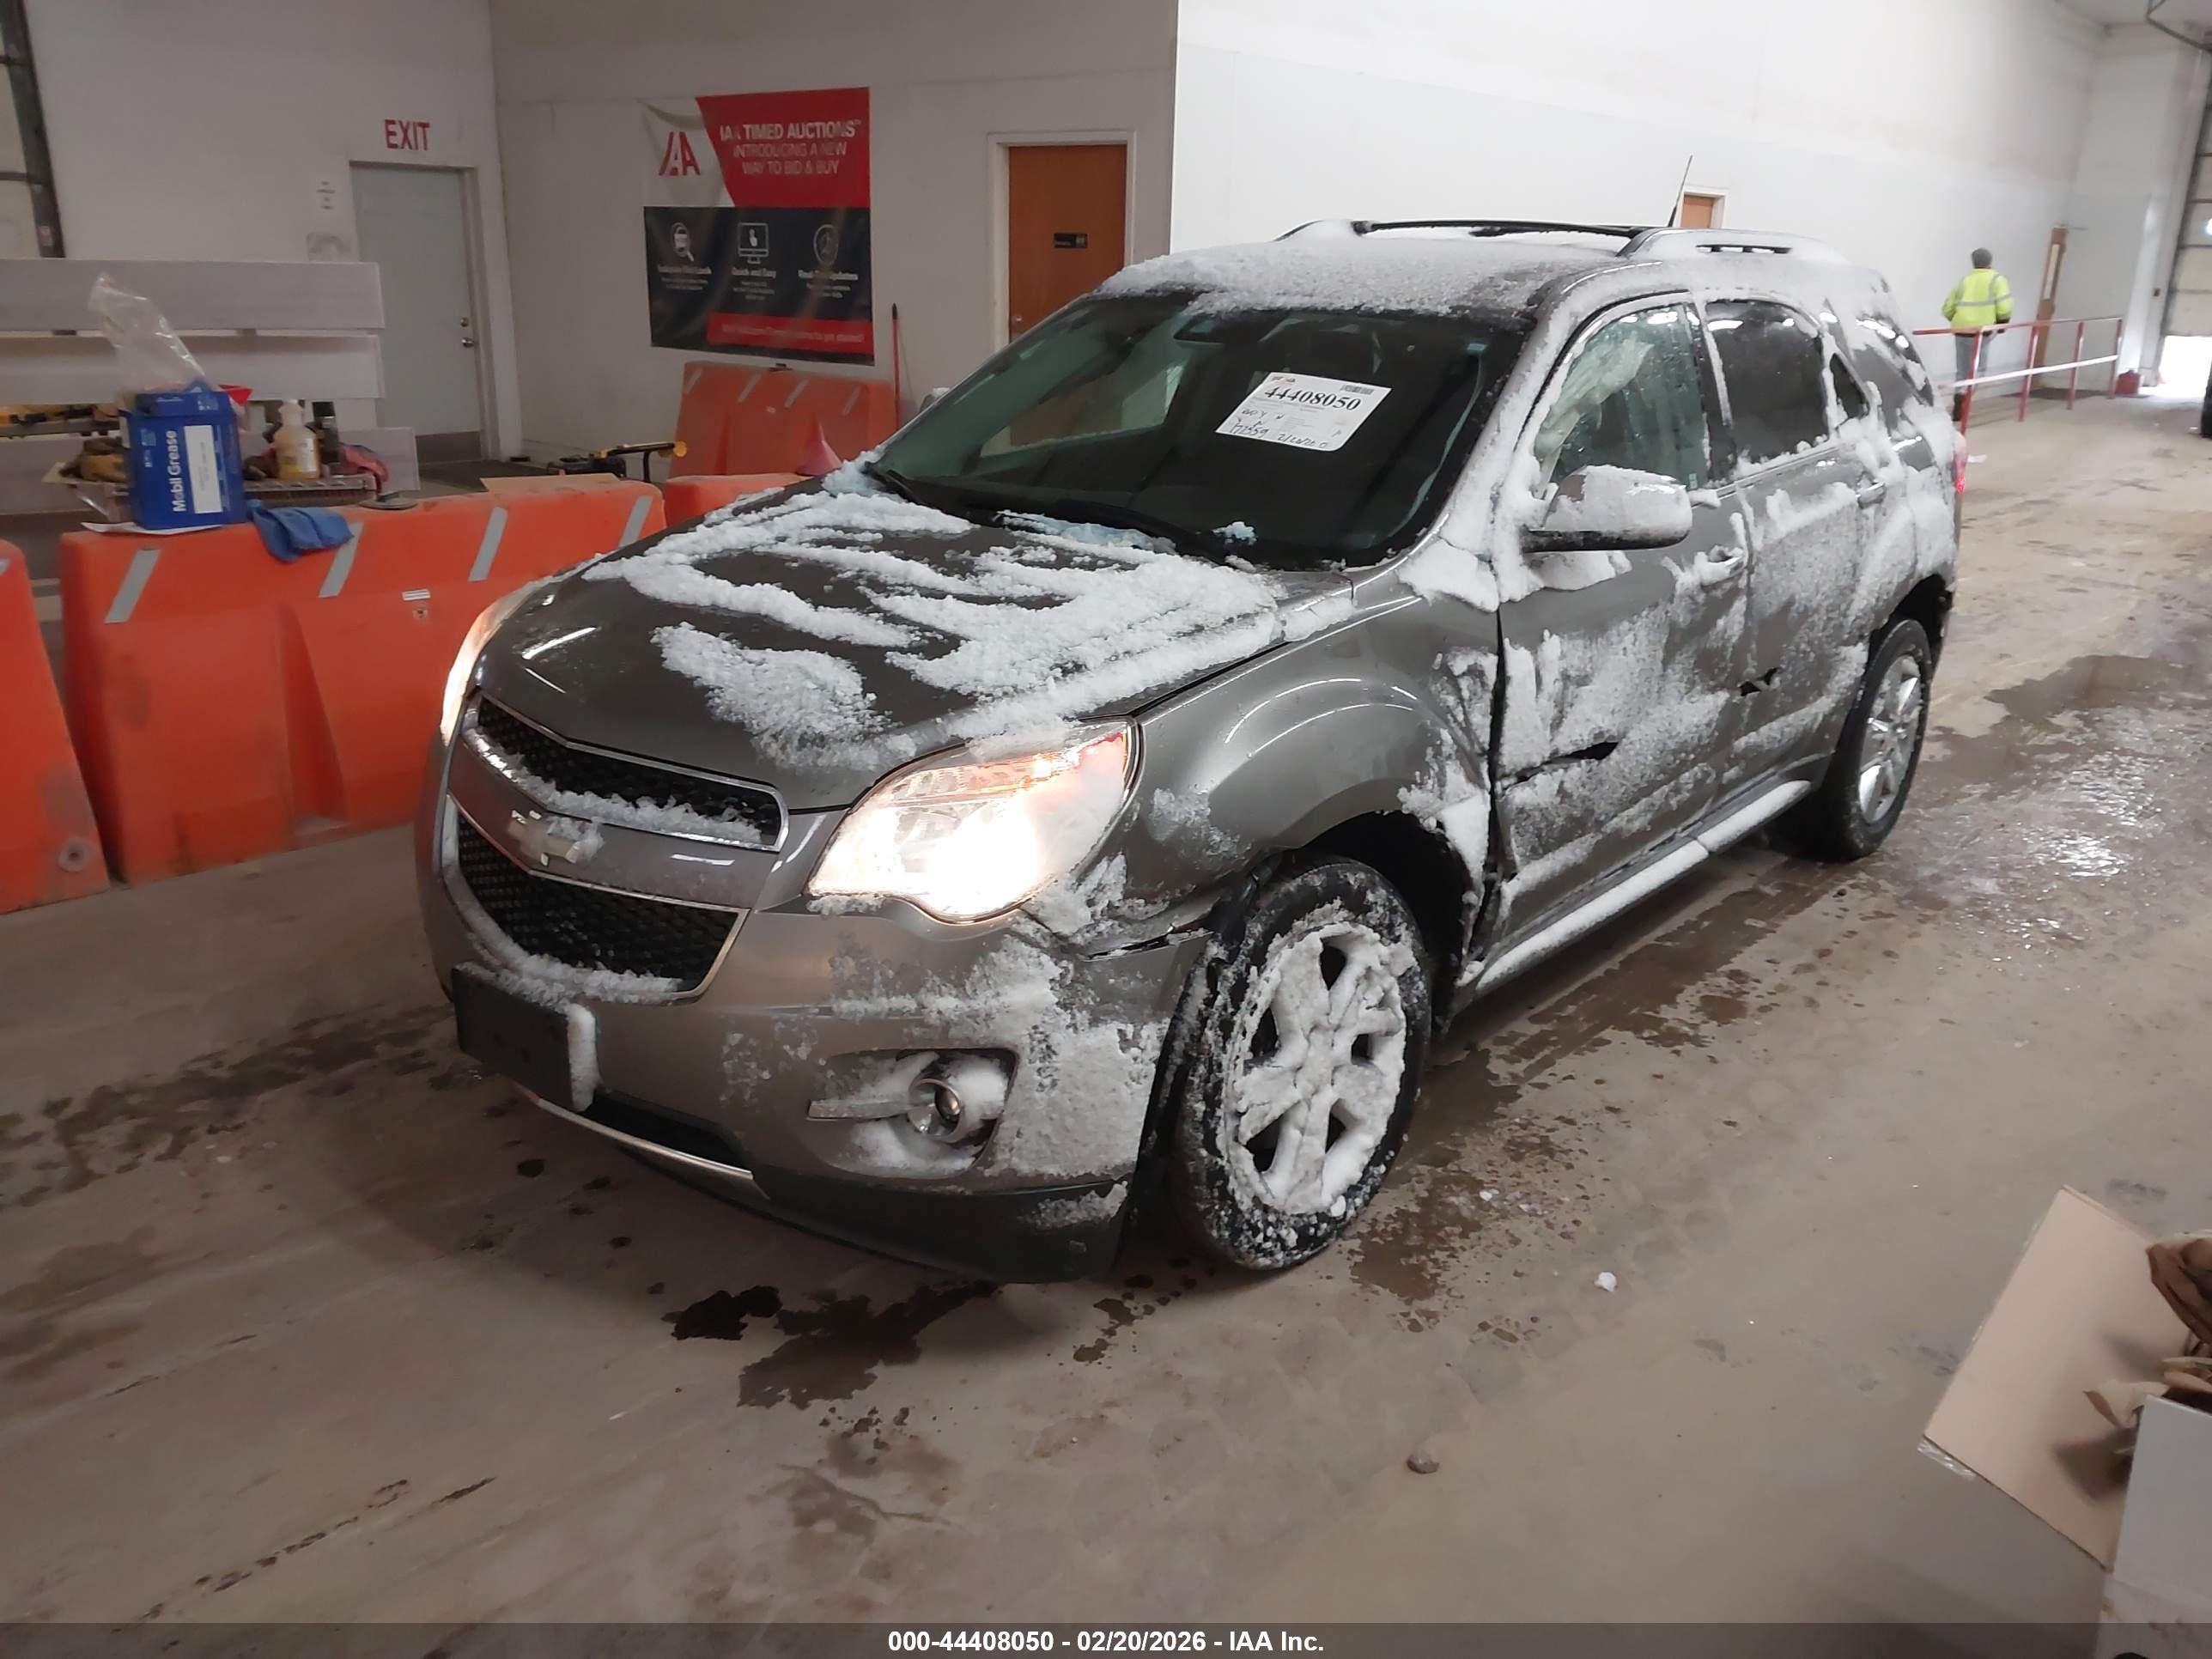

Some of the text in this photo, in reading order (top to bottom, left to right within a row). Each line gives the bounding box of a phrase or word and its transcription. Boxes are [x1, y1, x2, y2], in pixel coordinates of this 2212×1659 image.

[385, 119, 431, 151] EXIT
[743, 123, 784, 139] TIMED
[766, 161, 782, 174] TO
[1264, 386, 1361, 410] 44408050
[167, 431, 187, 512] Mobil Grease
